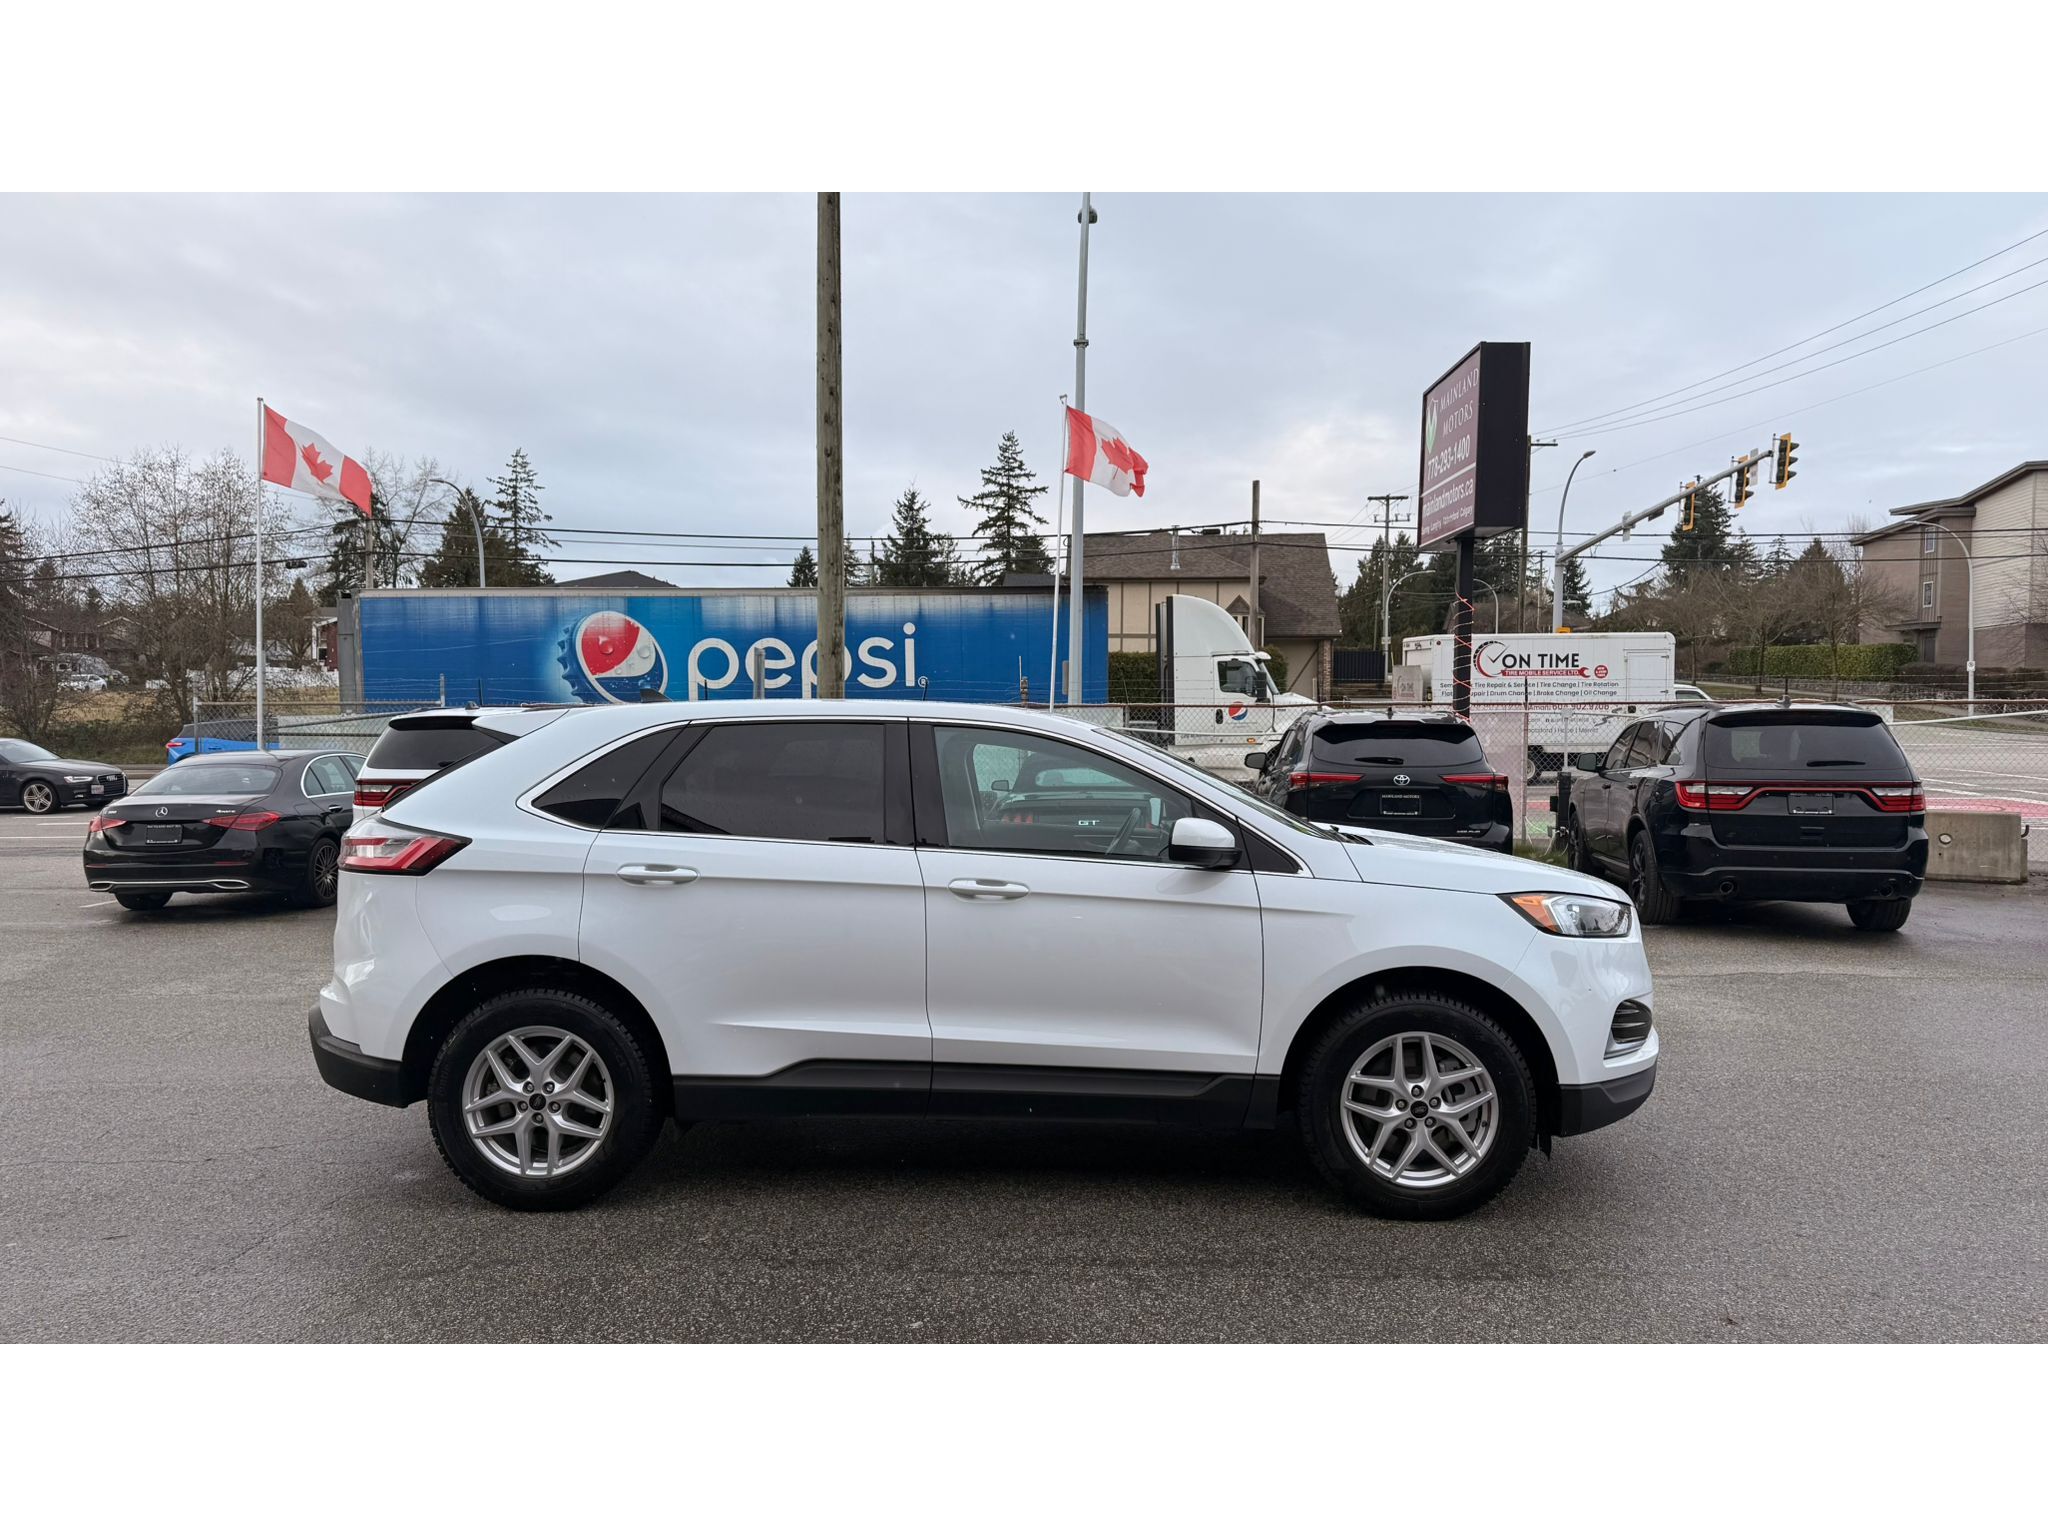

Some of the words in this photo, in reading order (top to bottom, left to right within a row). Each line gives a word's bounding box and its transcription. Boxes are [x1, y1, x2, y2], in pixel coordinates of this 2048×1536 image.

[1440, 367, 1479, 412] MAINLAND
[1443, 400, 1473, 437] MOTORS
[1427, 434, 1470, 481] 778-293-1400
[1502, 653, 1531, 669] ON
[1538, 653, 1580, 668] TIME
